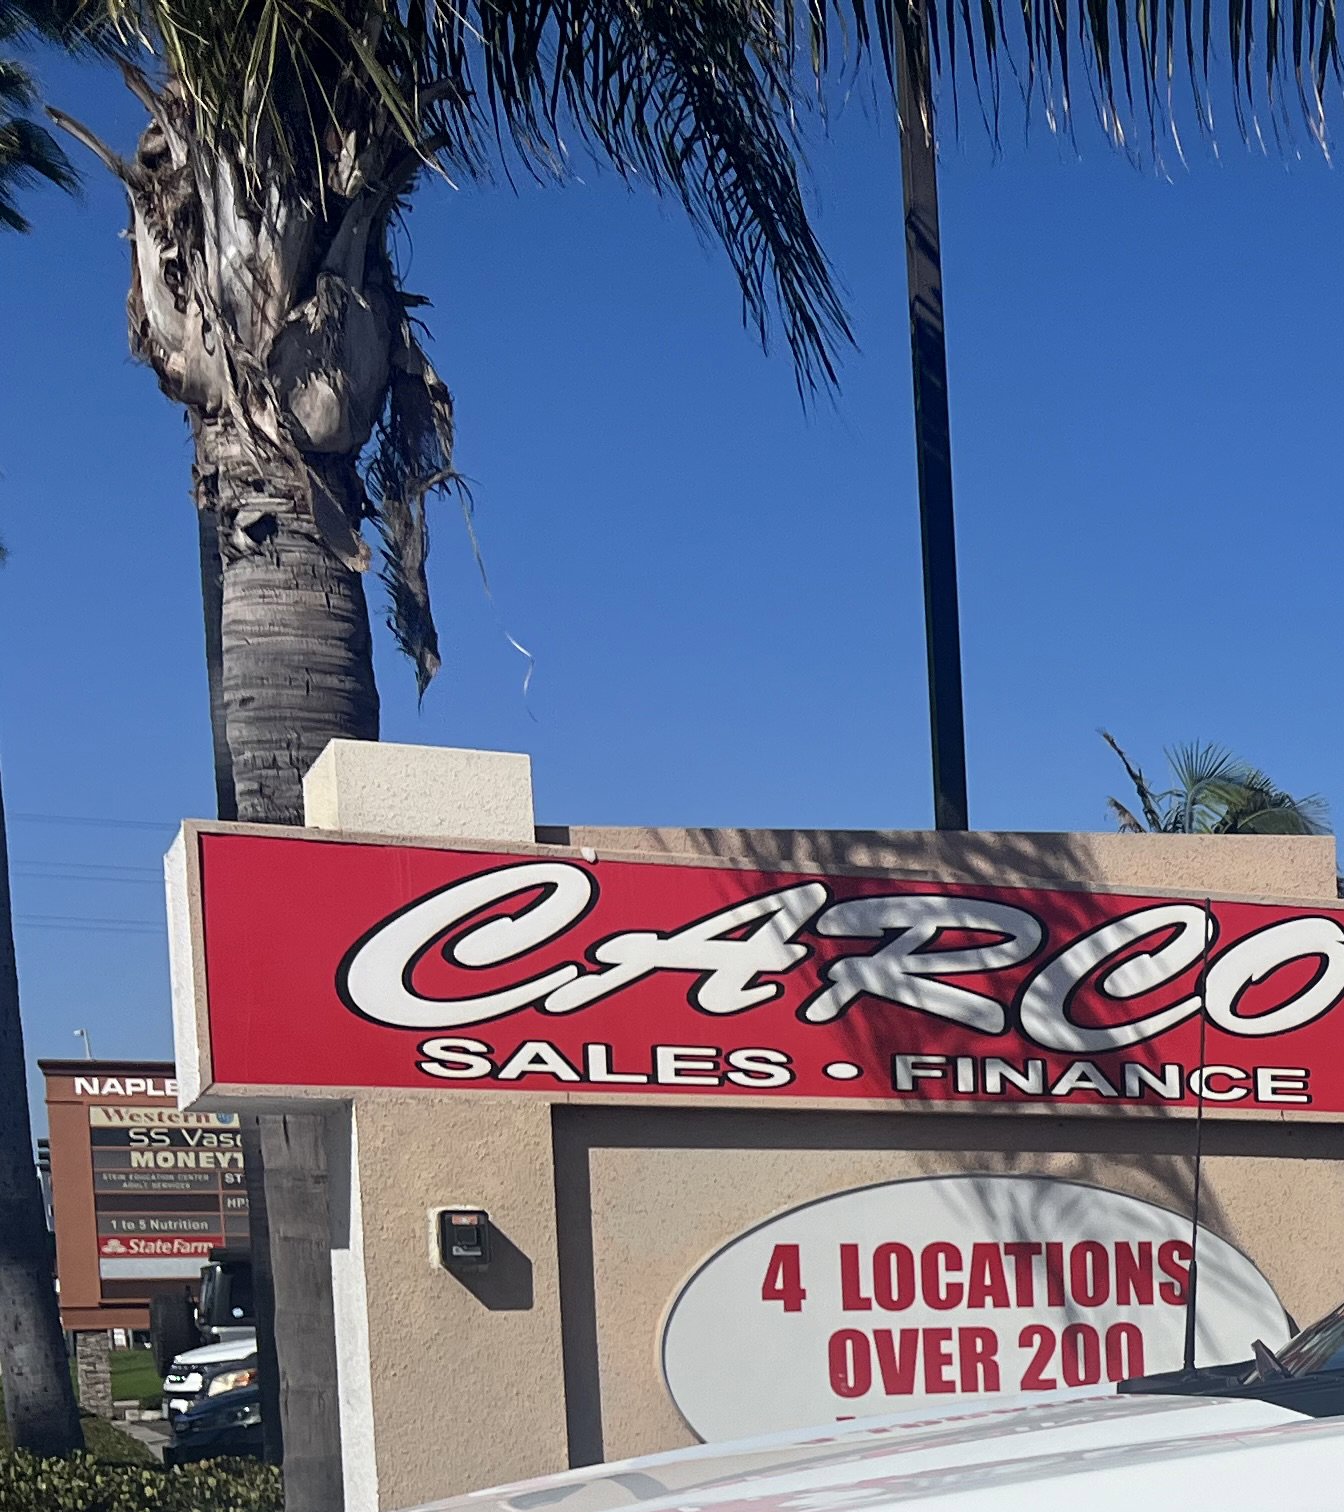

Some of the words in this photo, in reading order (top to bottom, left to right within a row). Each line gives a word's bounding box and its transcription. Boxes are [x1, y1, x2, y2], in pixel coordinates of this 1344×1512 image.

[417, 1036, 797, 1088] SALES
[892, 1054, 1312, 1104] FINANCE
[101, 1106, 210, 1123] Western
[128, 1128, 170, 1147] SS
[122, 1219, 135, 1230] to
[138, 1219, 146, 1230] 5
[150, 1219, 209, 1230] Nutrition
[761, 1243, 806, 1313] 4
[839, 1239, 1192, 1312] LOCATIONS
[827, 1326, 1000, 1399] OVER
[1018, 1322, 1145, 1391] 200
